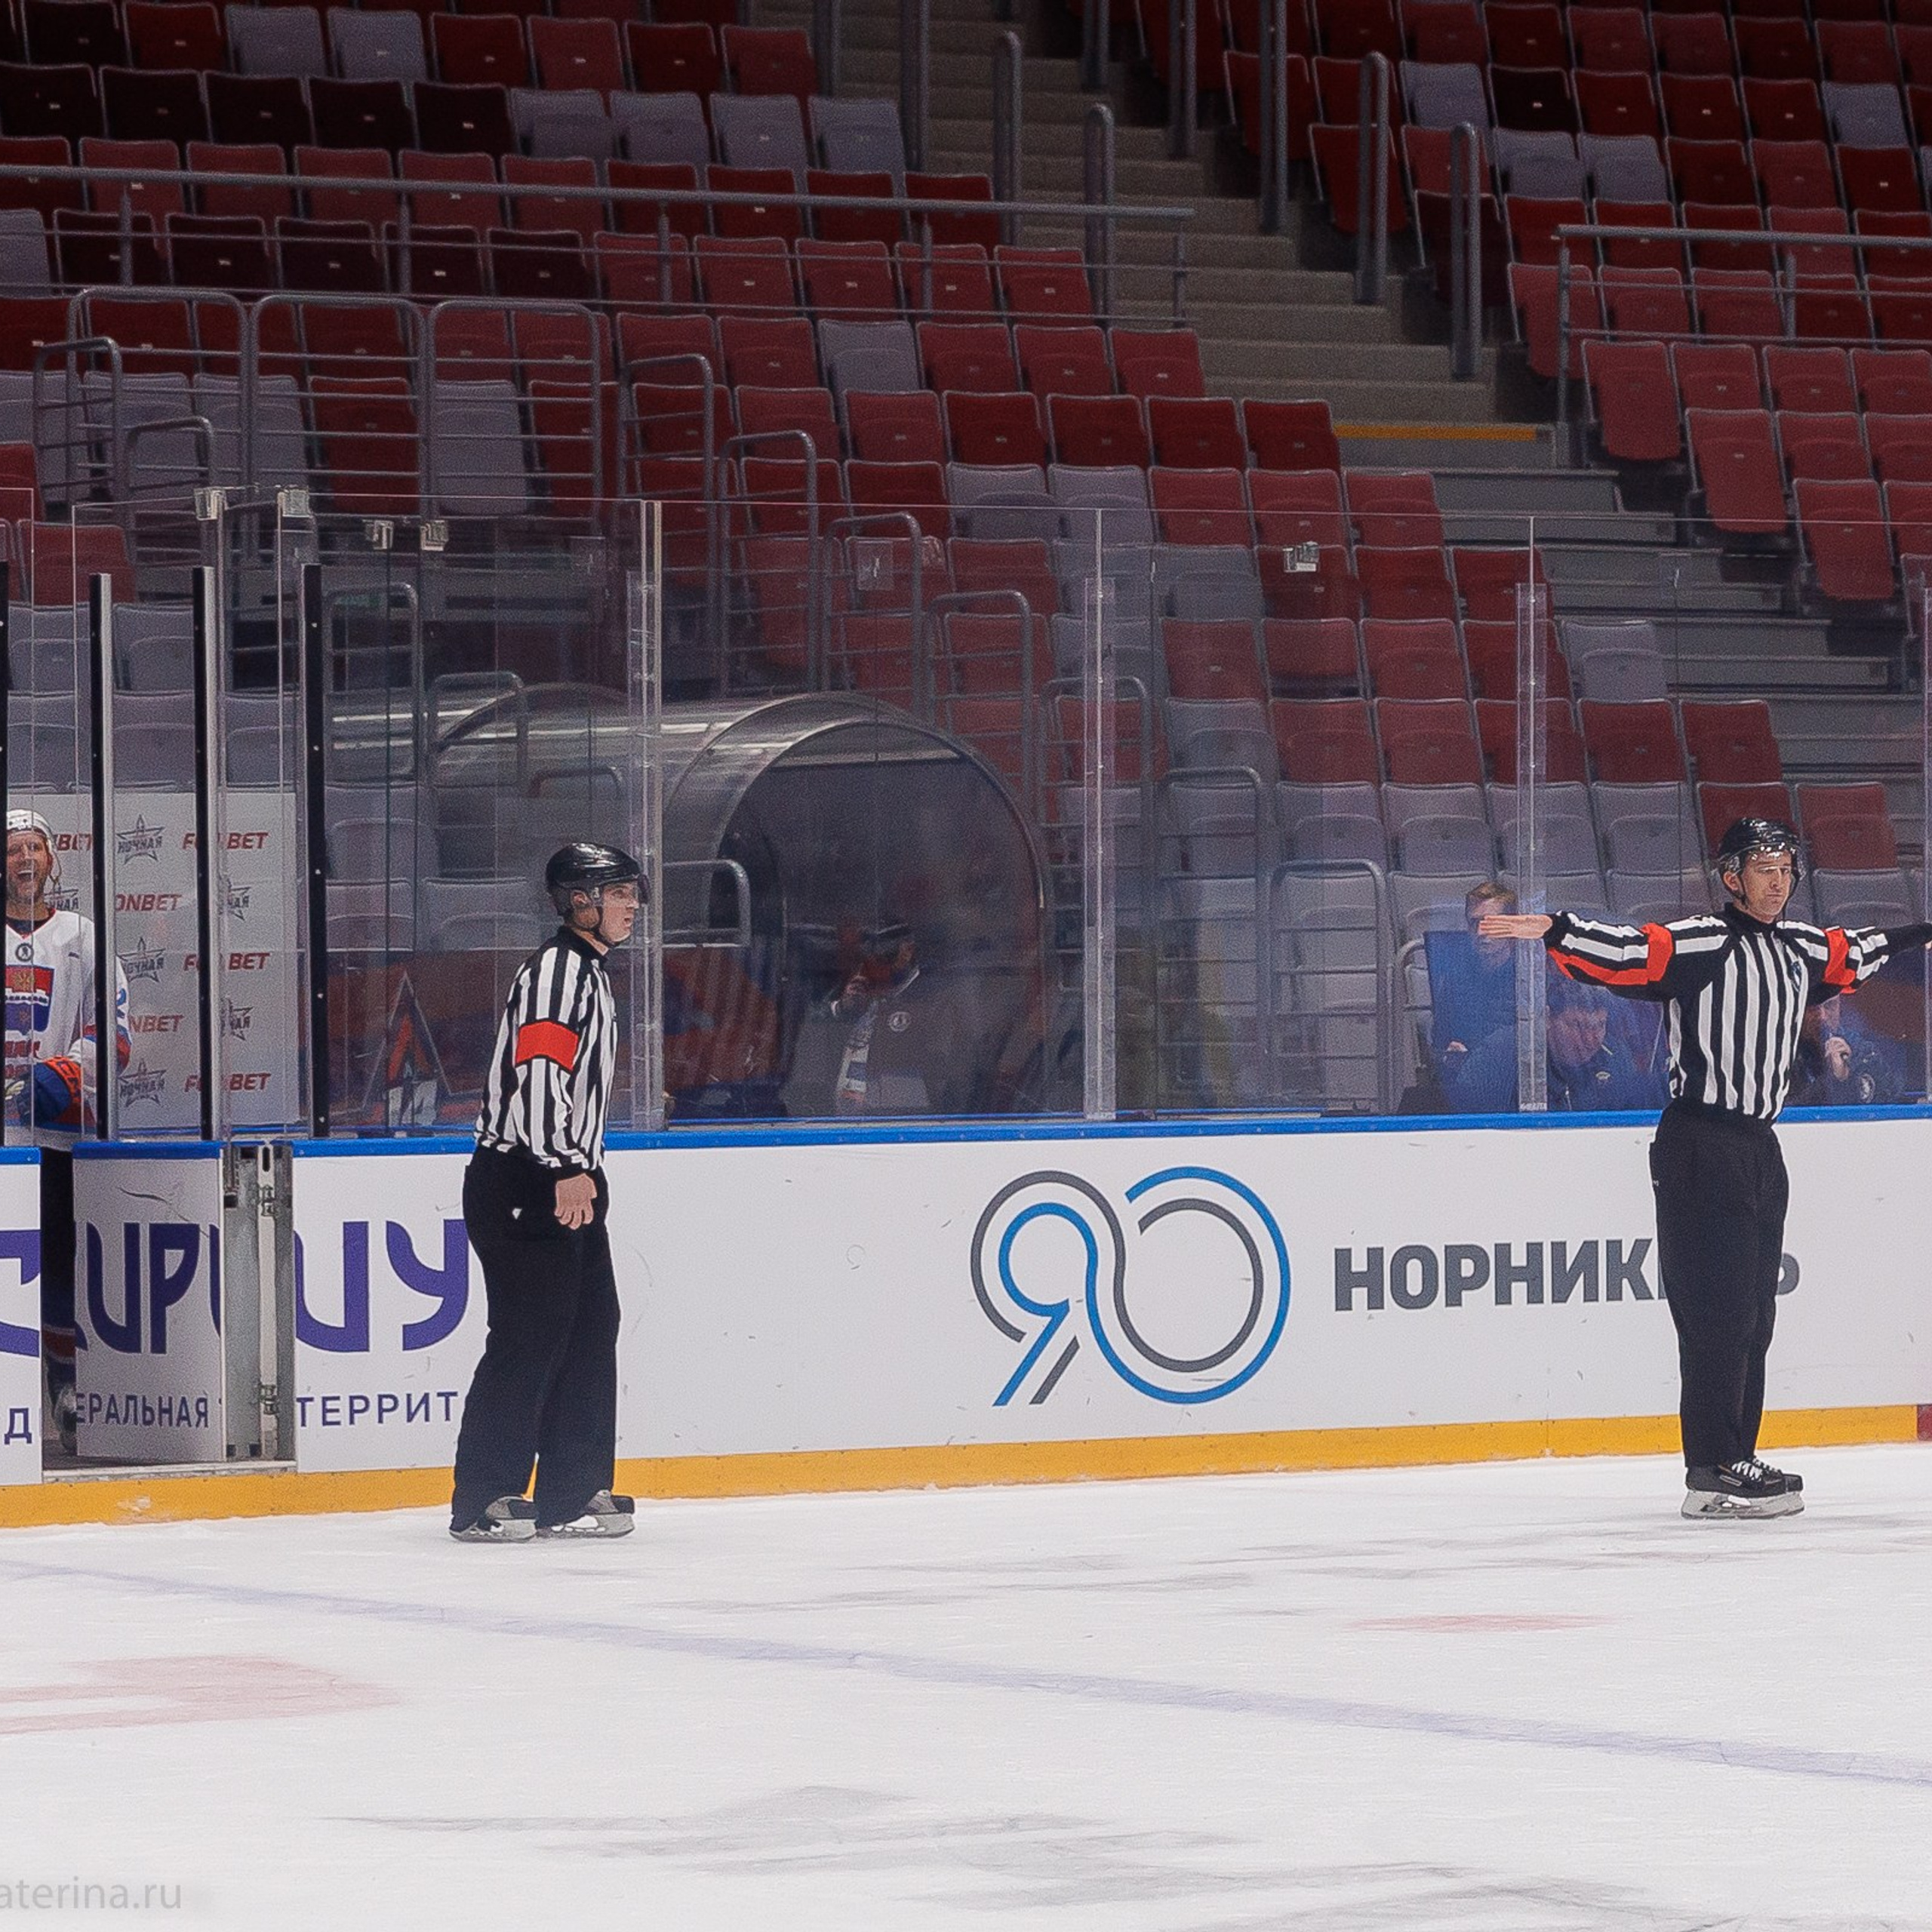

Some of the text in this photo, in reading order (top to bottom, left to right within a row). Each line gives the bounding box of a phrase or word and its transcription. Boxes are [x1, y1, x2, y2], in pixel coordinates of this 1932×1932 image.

[54, 834, 93, 851] BET
[182, 832, 269, 850] FBET
[115, 894, 182, 912] ONBET
[183, 952, 270, 971] FBET
[128, 1014, 184, 1032] NBET
[185, 1072, 271, 1092] FBET
[1334, 1238, 1800, 1311] НОРНИК
